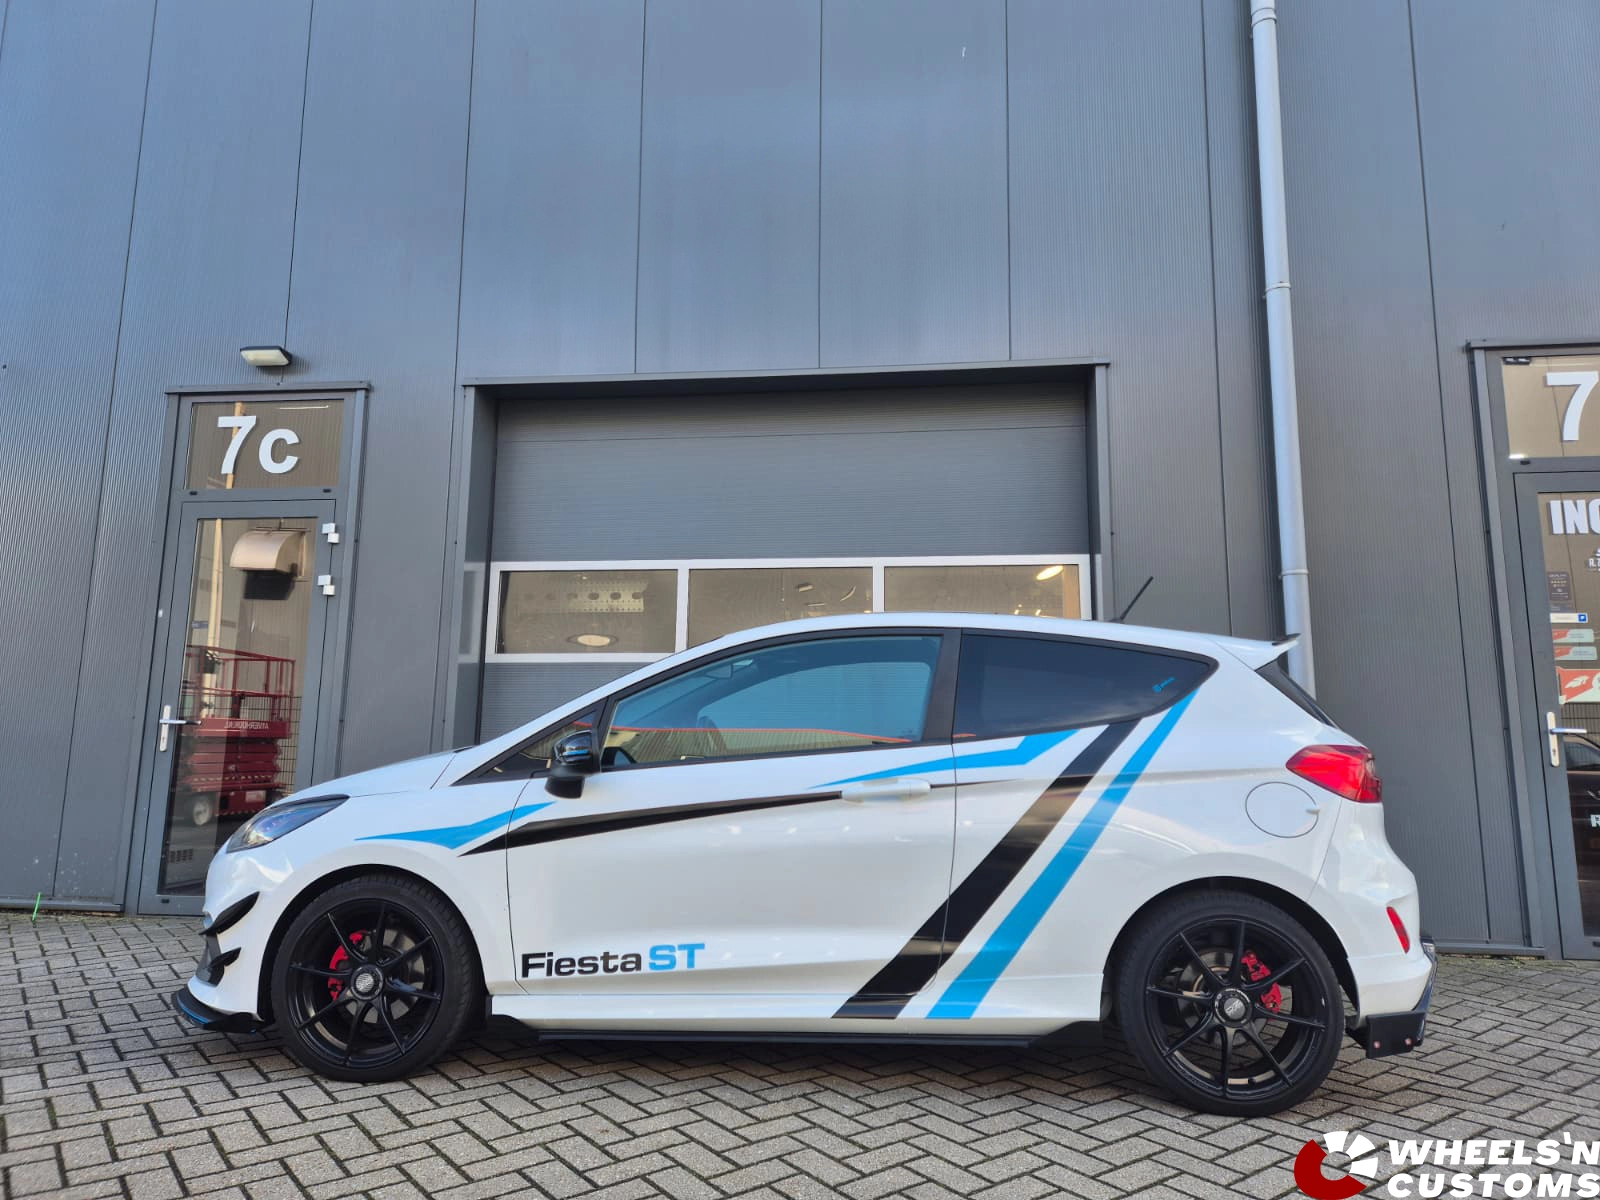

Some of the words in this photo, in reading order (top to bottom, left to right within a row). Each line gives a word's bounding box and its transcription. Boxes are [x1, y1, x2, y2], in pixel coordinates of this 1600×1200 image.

[1546, 371, 1599, 441] 7
[521, 951, 642, 978] Fiesta
[648, 943, 705, 971] ST
